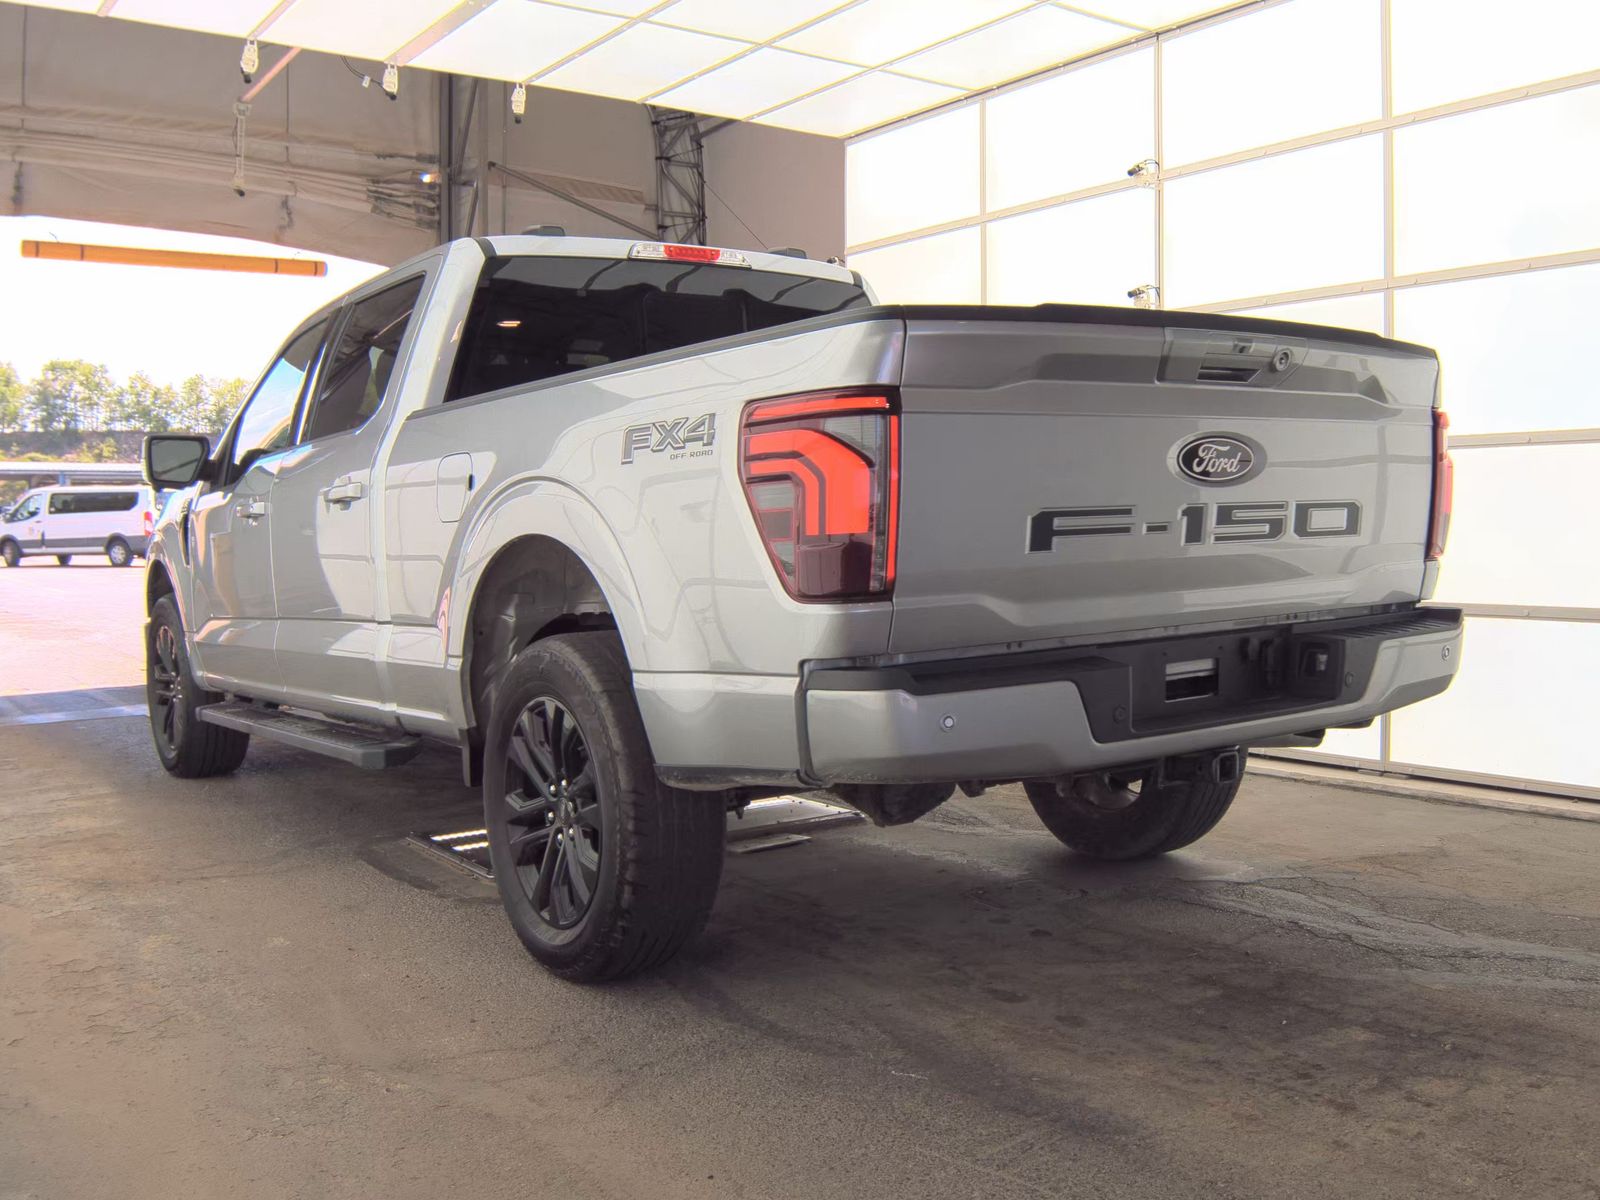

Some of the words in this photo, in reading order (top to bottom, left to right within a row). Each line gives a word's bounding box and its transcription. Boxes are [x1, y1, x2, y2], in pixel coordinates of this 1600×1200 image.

[621, 412, 716, 465] FX4
[669, 452, 687, 460] OFF
[689, 449, 713, 458] ROAD
[1192, 443, 1242, 473] Ford
[1025, 499, 1363, 554] F-150
